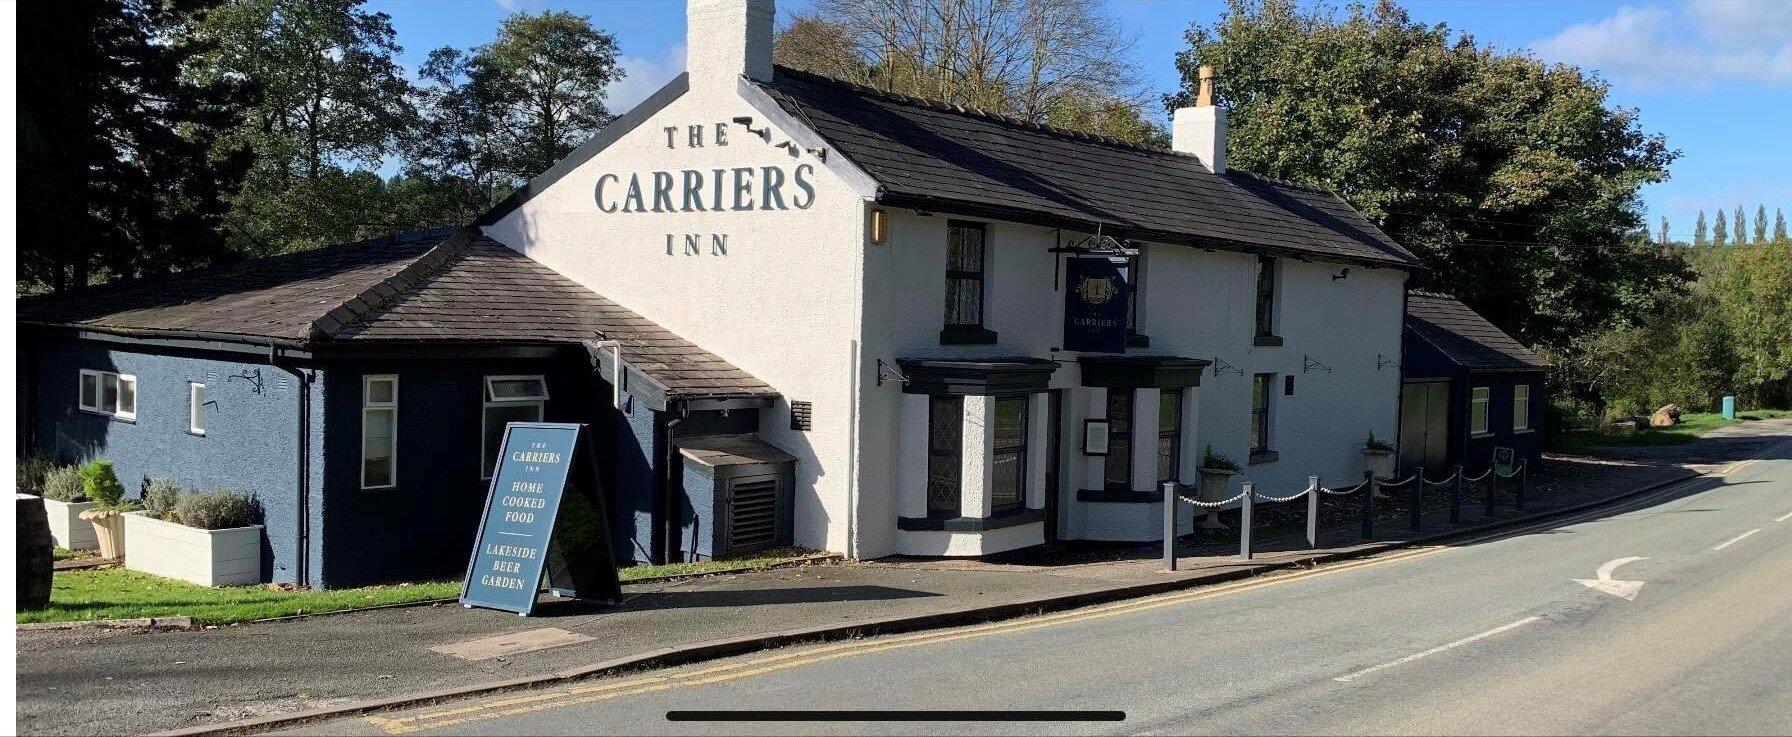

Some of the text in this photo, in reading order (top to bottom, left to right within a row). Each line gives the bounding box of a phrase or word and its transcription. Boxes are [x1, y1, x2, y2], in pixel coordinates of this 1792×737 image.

[664, 122, 729, 149] THE
[594, 163, 816, 213] CARRIERS
[665, 233, 729, 256] INN
[512, 451, 561, 463] CARRIERS
[511, 481, 544, 493] HOME
[502, 496, 546, 509] COOKED
[504, 511, 535, 524] FOOD
[486, 544, 537, 560] LAKESIDE
[493, 560, 521, 573] BEER
[481, 574, 526, 590] GARDEN
